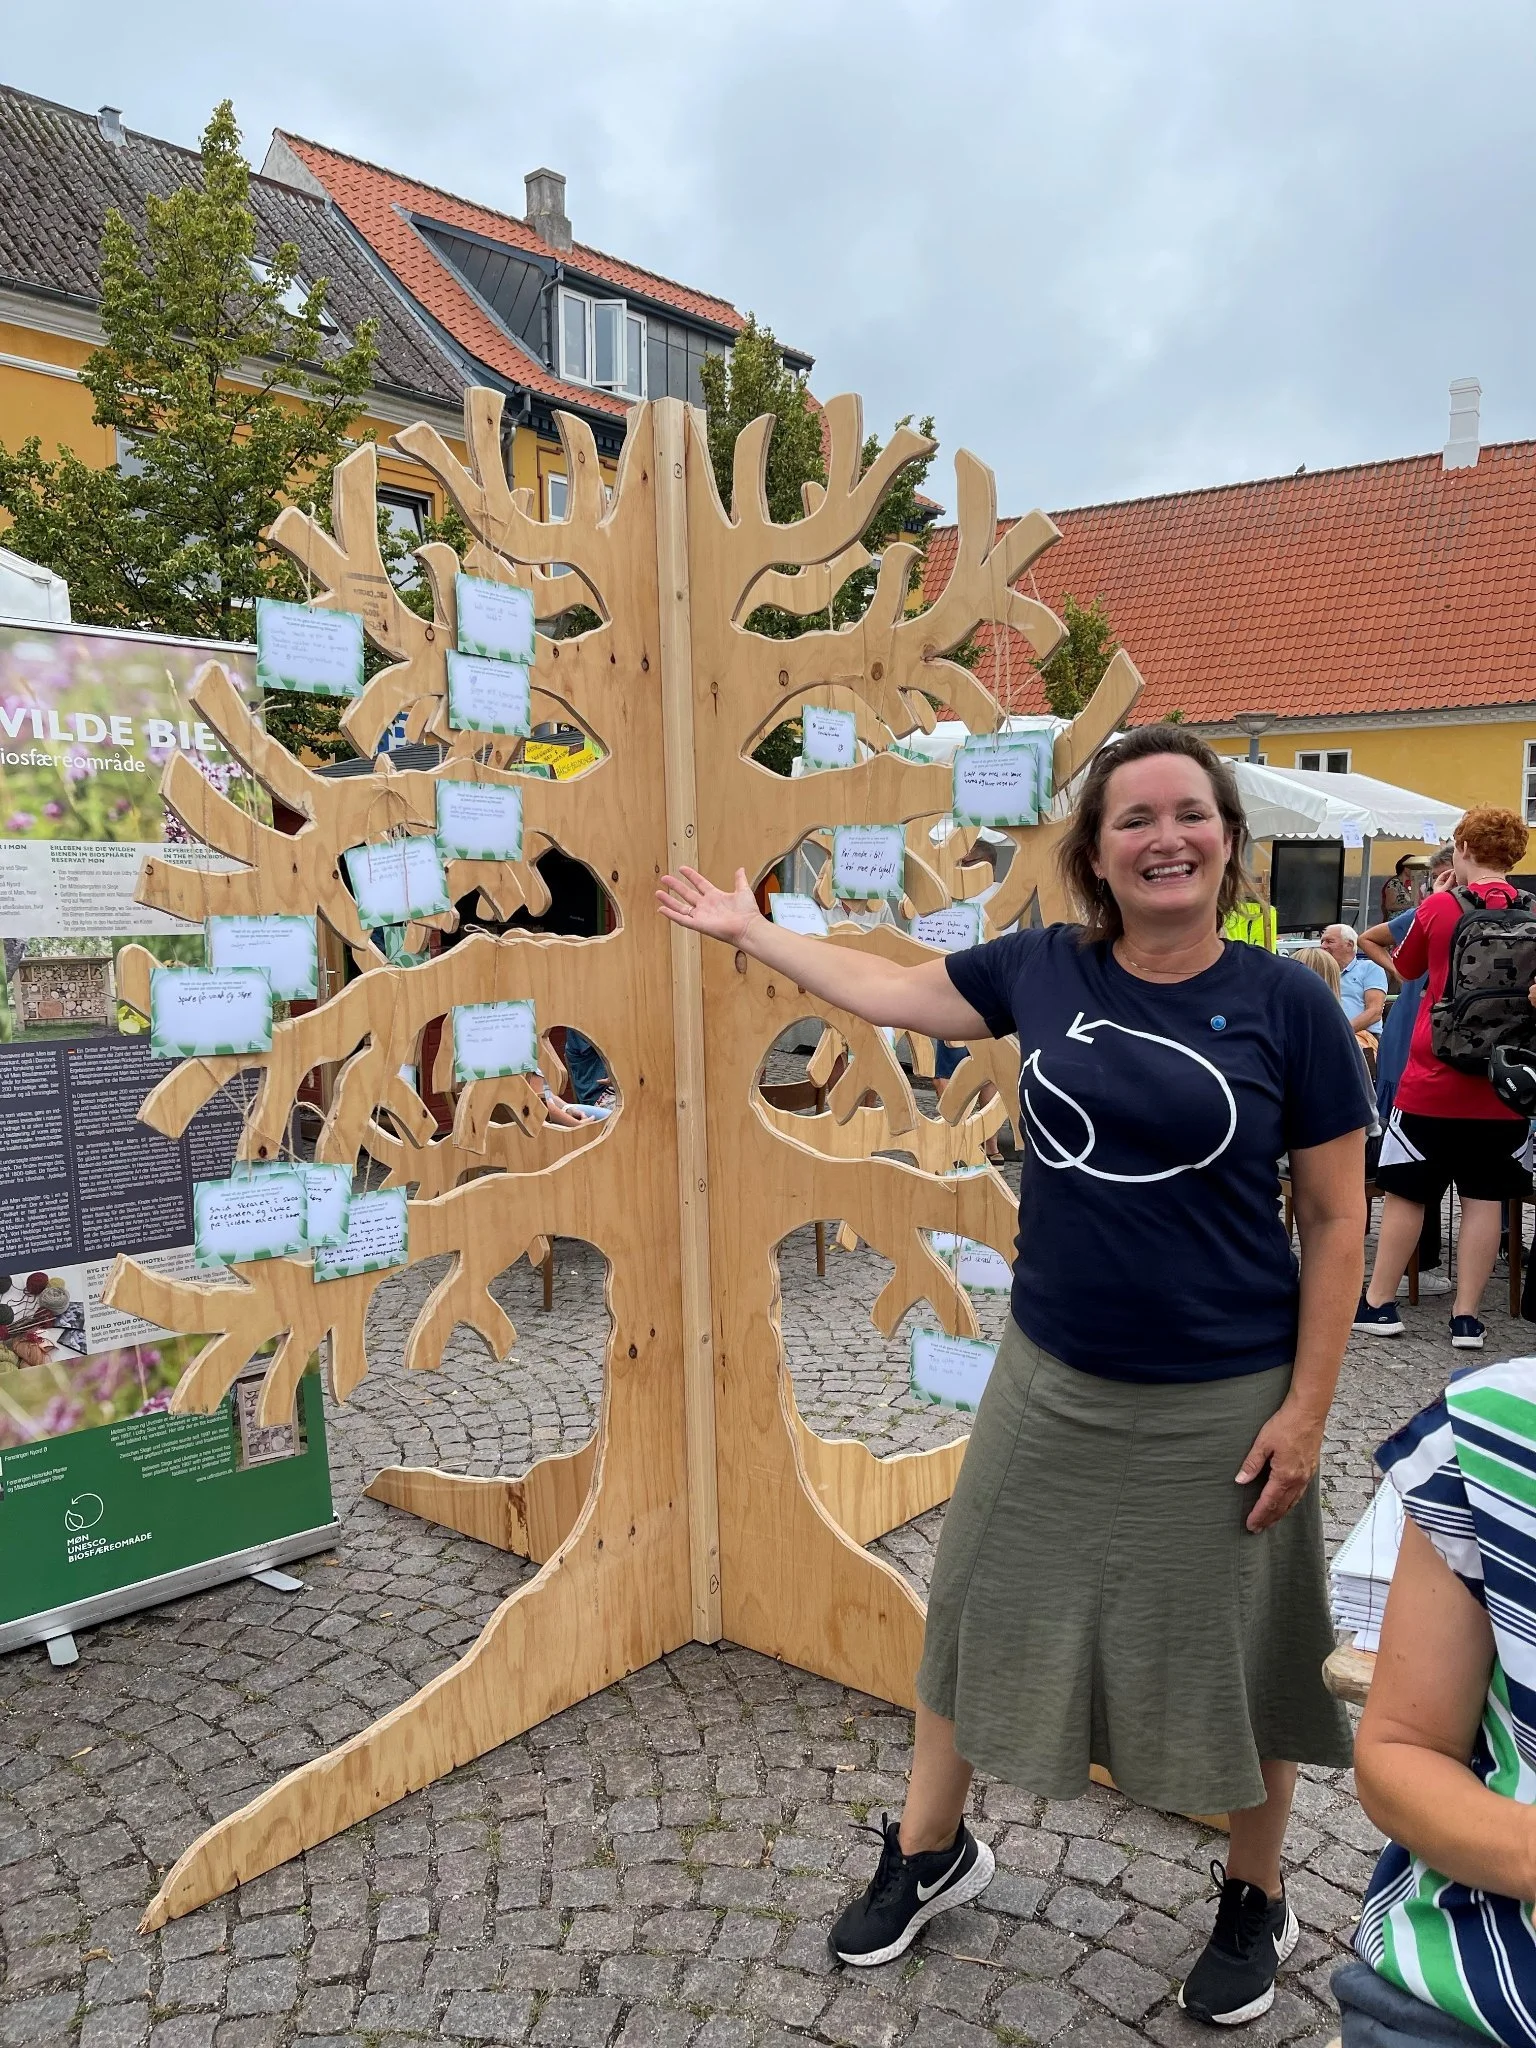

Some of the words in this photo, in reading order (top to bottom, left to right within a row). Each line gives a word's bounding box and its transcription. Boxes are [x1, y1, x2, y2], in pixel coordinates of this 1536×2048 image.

[0, 706, 135, 746] VILDE
[148, 718, 228, 752] BIE
[0, 748, 146, 773] iosfæreområde
[91, 1323, 112, 1332] BUILD
[113, 1320, 131, 1328] YOUR
[67, 1534, 89, 1546] MØN
[67, 1538, 106, 1554] UNESCO
[68, 1531, 152, 1563] BIOSFÆREOMRÅDE
